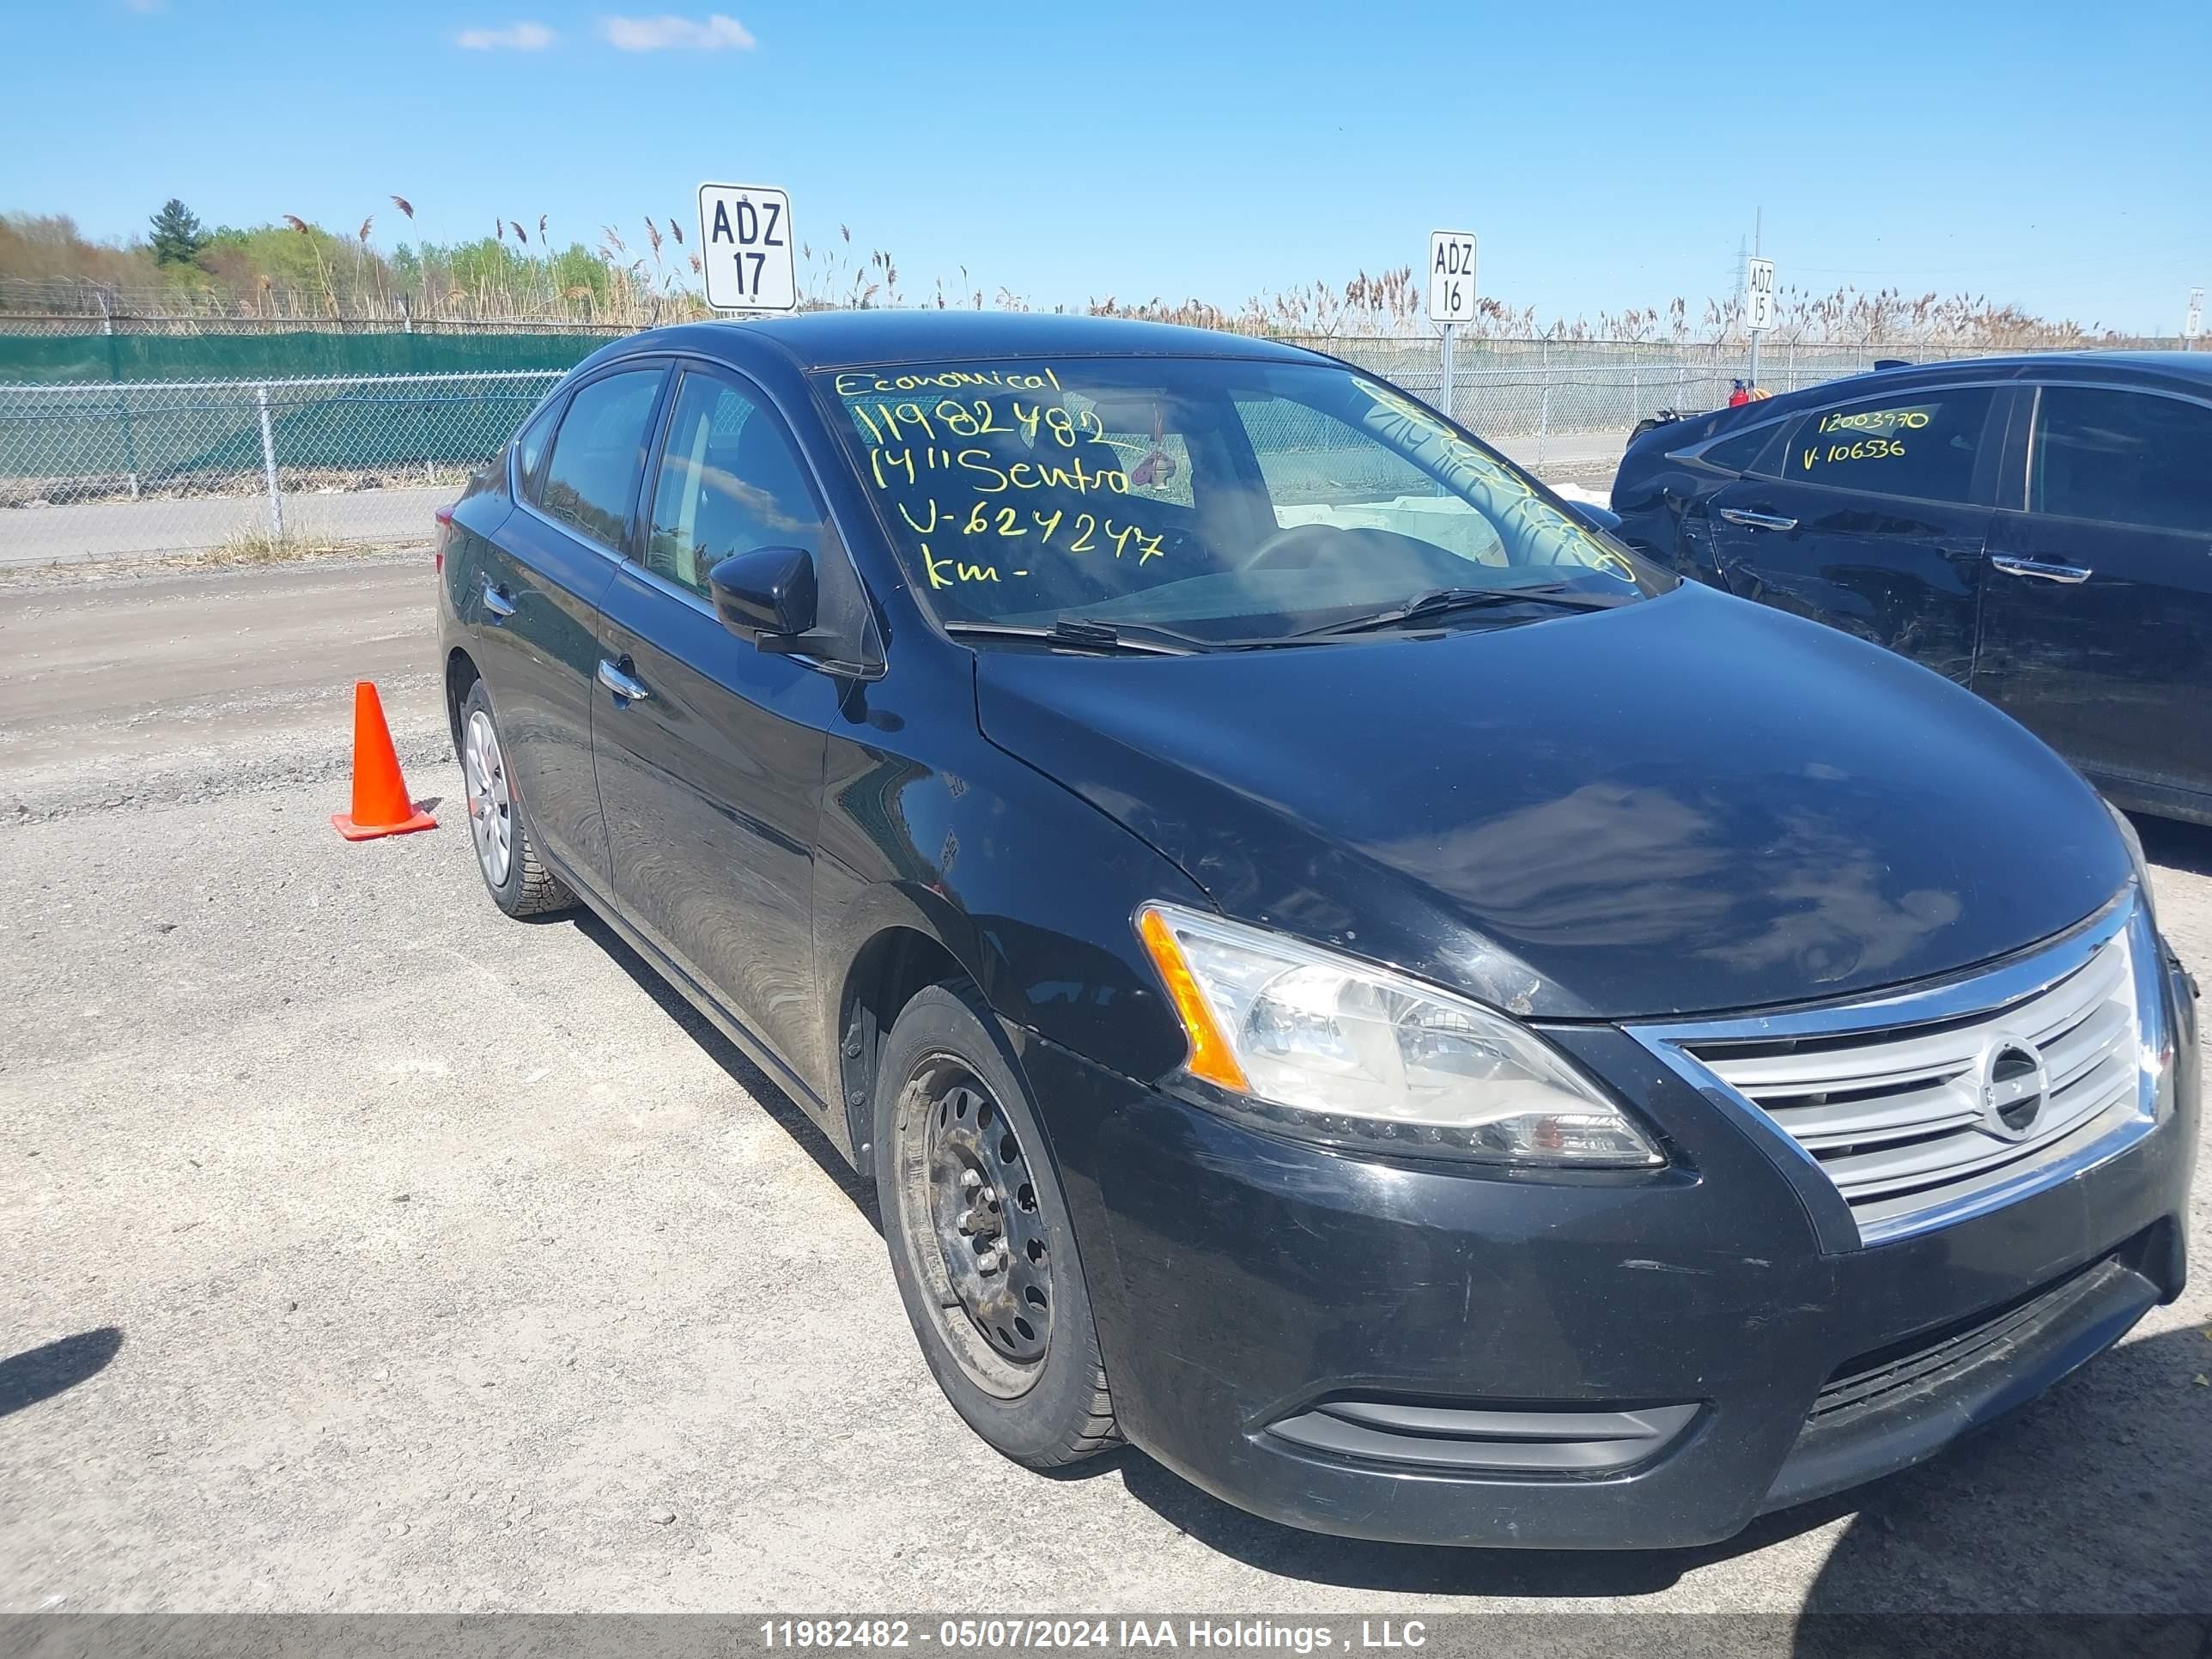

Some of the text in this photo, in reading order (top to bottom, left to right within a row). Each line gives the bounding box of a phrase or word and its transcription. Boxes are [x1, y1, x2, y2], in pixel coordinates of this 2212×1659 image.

[712, 200, 784, 246] ADZ
[733, 252, 766, 295] 17
[1435, 242, 1472, 275] ADZ
[1750, 267, 1772, 294] ADZ
[1443, 280, 1462, 312] 16
[1753, 296, 1765, 321] 15
[835, 368, 1061, 396] Economical
[854, 400, 1147, 451] 11982482
[1818, 412, 1929, 434] 12003970
[1827, 440, 1905, 463] 106536
